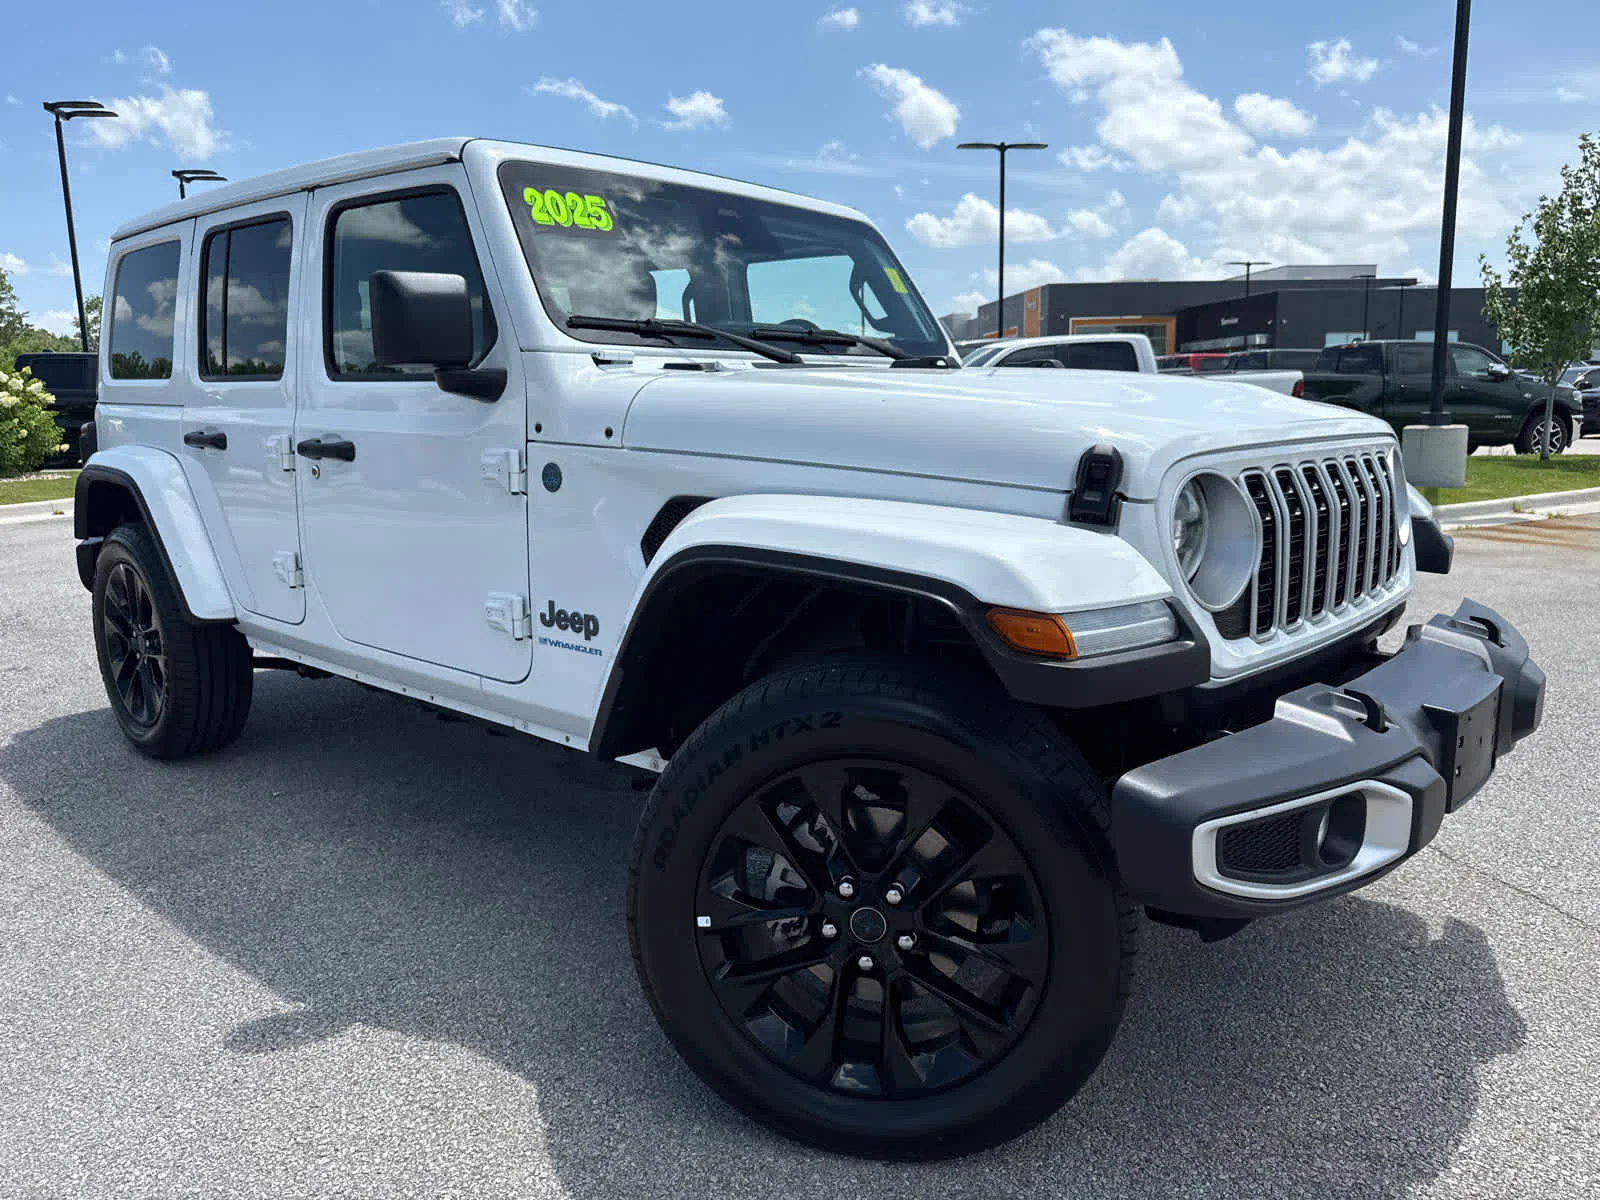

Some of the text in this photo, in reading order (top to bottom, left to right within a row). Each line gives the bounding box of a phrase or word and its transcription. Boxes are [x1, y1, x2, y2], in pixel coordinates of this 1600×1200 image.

[523, 187, 613, 231] 2025
[540, 600, 599, 641] Jeep
[548, 639, 603, 656] WRANGLER
